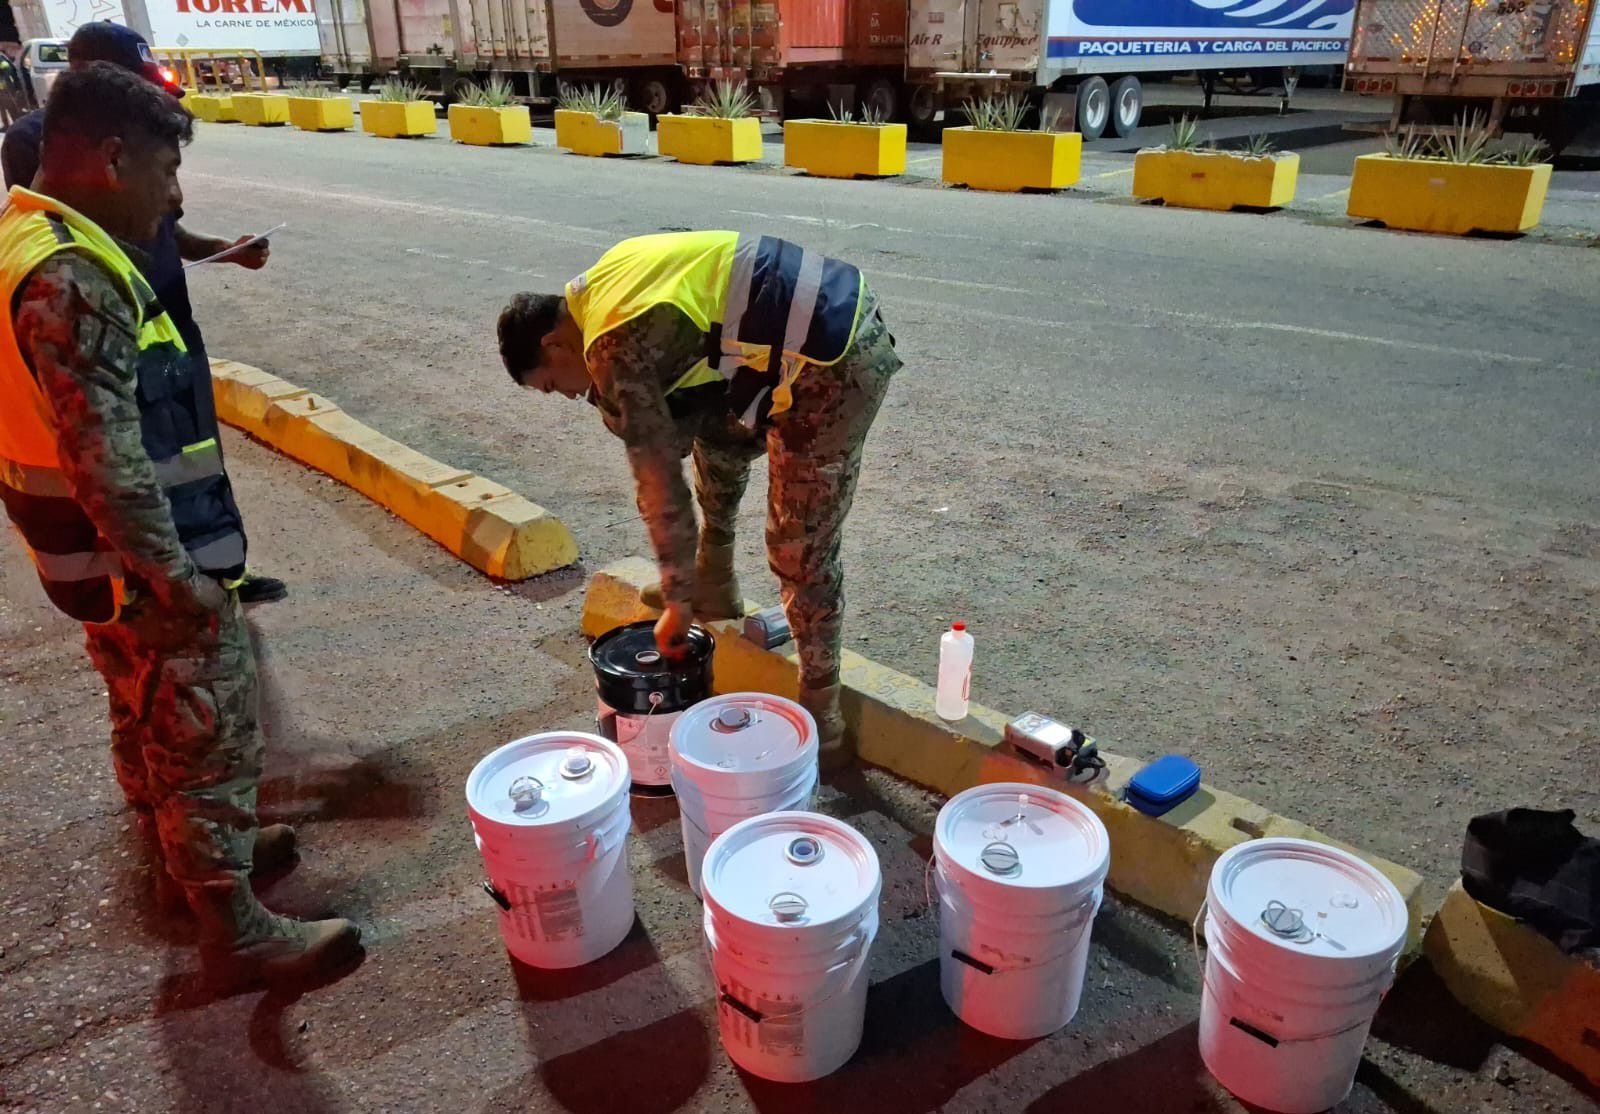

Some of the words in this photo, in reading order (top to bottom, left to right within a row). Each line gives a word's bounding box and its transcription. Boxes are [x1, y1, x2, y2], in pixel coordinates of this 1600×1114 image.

[196, 20, 211, 28] LA
[214, 20, 252, 28] CARNE
[911, 33, 930, 45] Air
[931, 34, 943, 45] R
[1078, 41, 1192, 55] PAQUETERIA
[1197, 41, 1208, 53] Y
[1212, 41, 1262, 52] CARGA
[1265, 41, 1288, 51] DEL
[1292, 41, 1342, 51] PACIFICO
